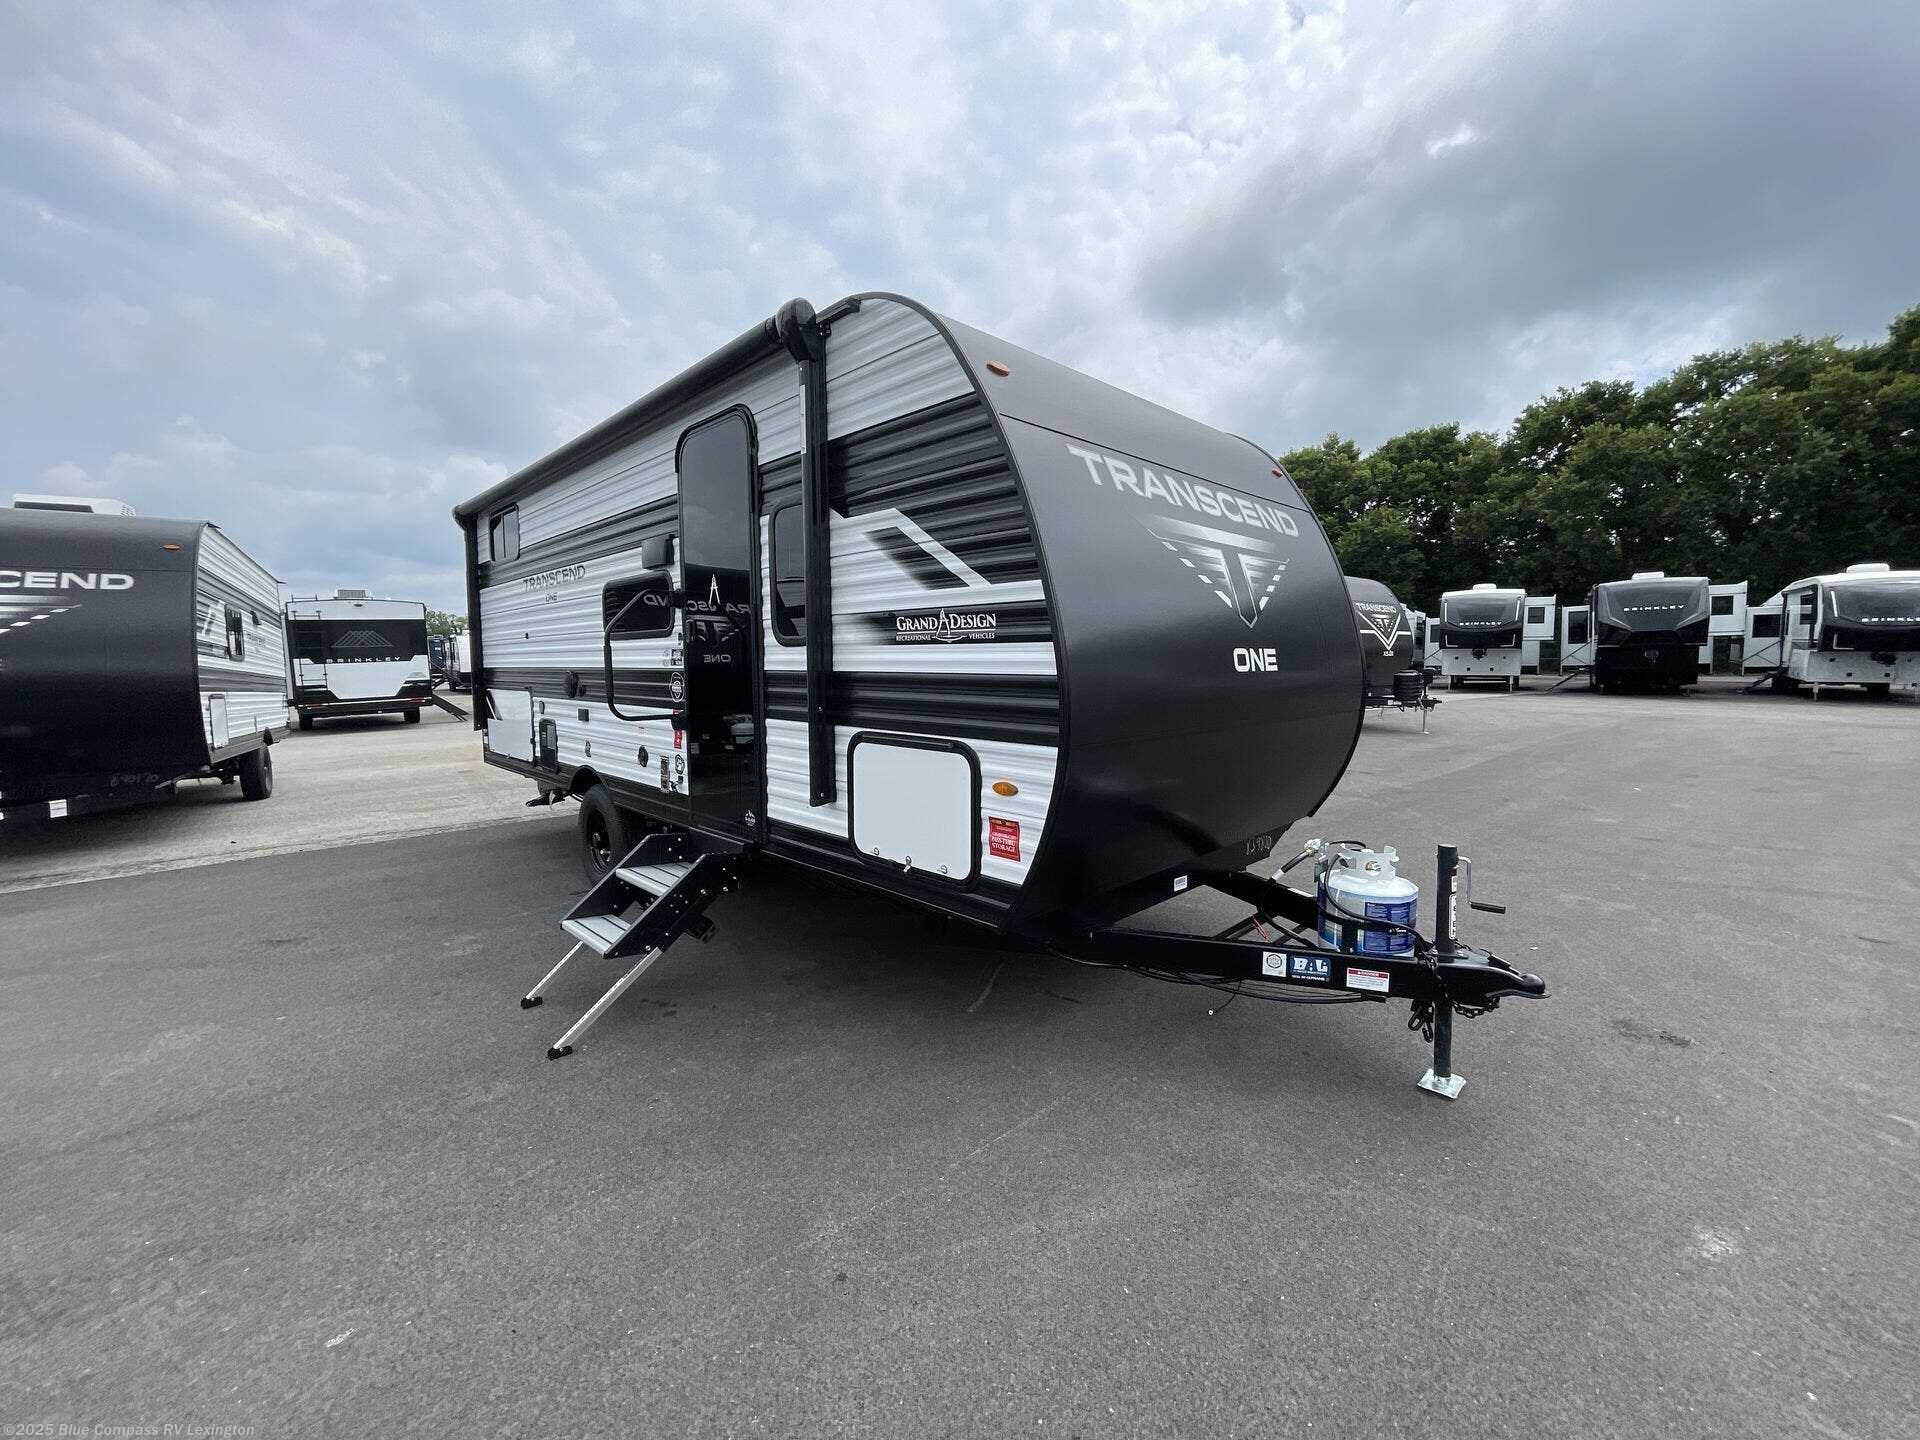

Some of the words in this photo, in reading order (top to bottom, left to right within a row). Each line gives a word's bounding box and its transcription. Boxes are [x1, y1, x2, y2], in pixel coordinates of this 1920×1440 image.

[1066, 443, 1299, 538] TRANSCEND
[523, 564, 586, 592] TRANSCEND
[1355, 602, 1397, 613] TRANSCEND
[896, 616, 938, 631] GRAND
[948, 613, 997, 629] DESIGN
[968, 632, 995, 640] VEHICLES
[326, 656, 401, 664] BRINKLEY
[1233, 647, 1279, 672] ONE
[1293, 957, 1328, 972] BAL
